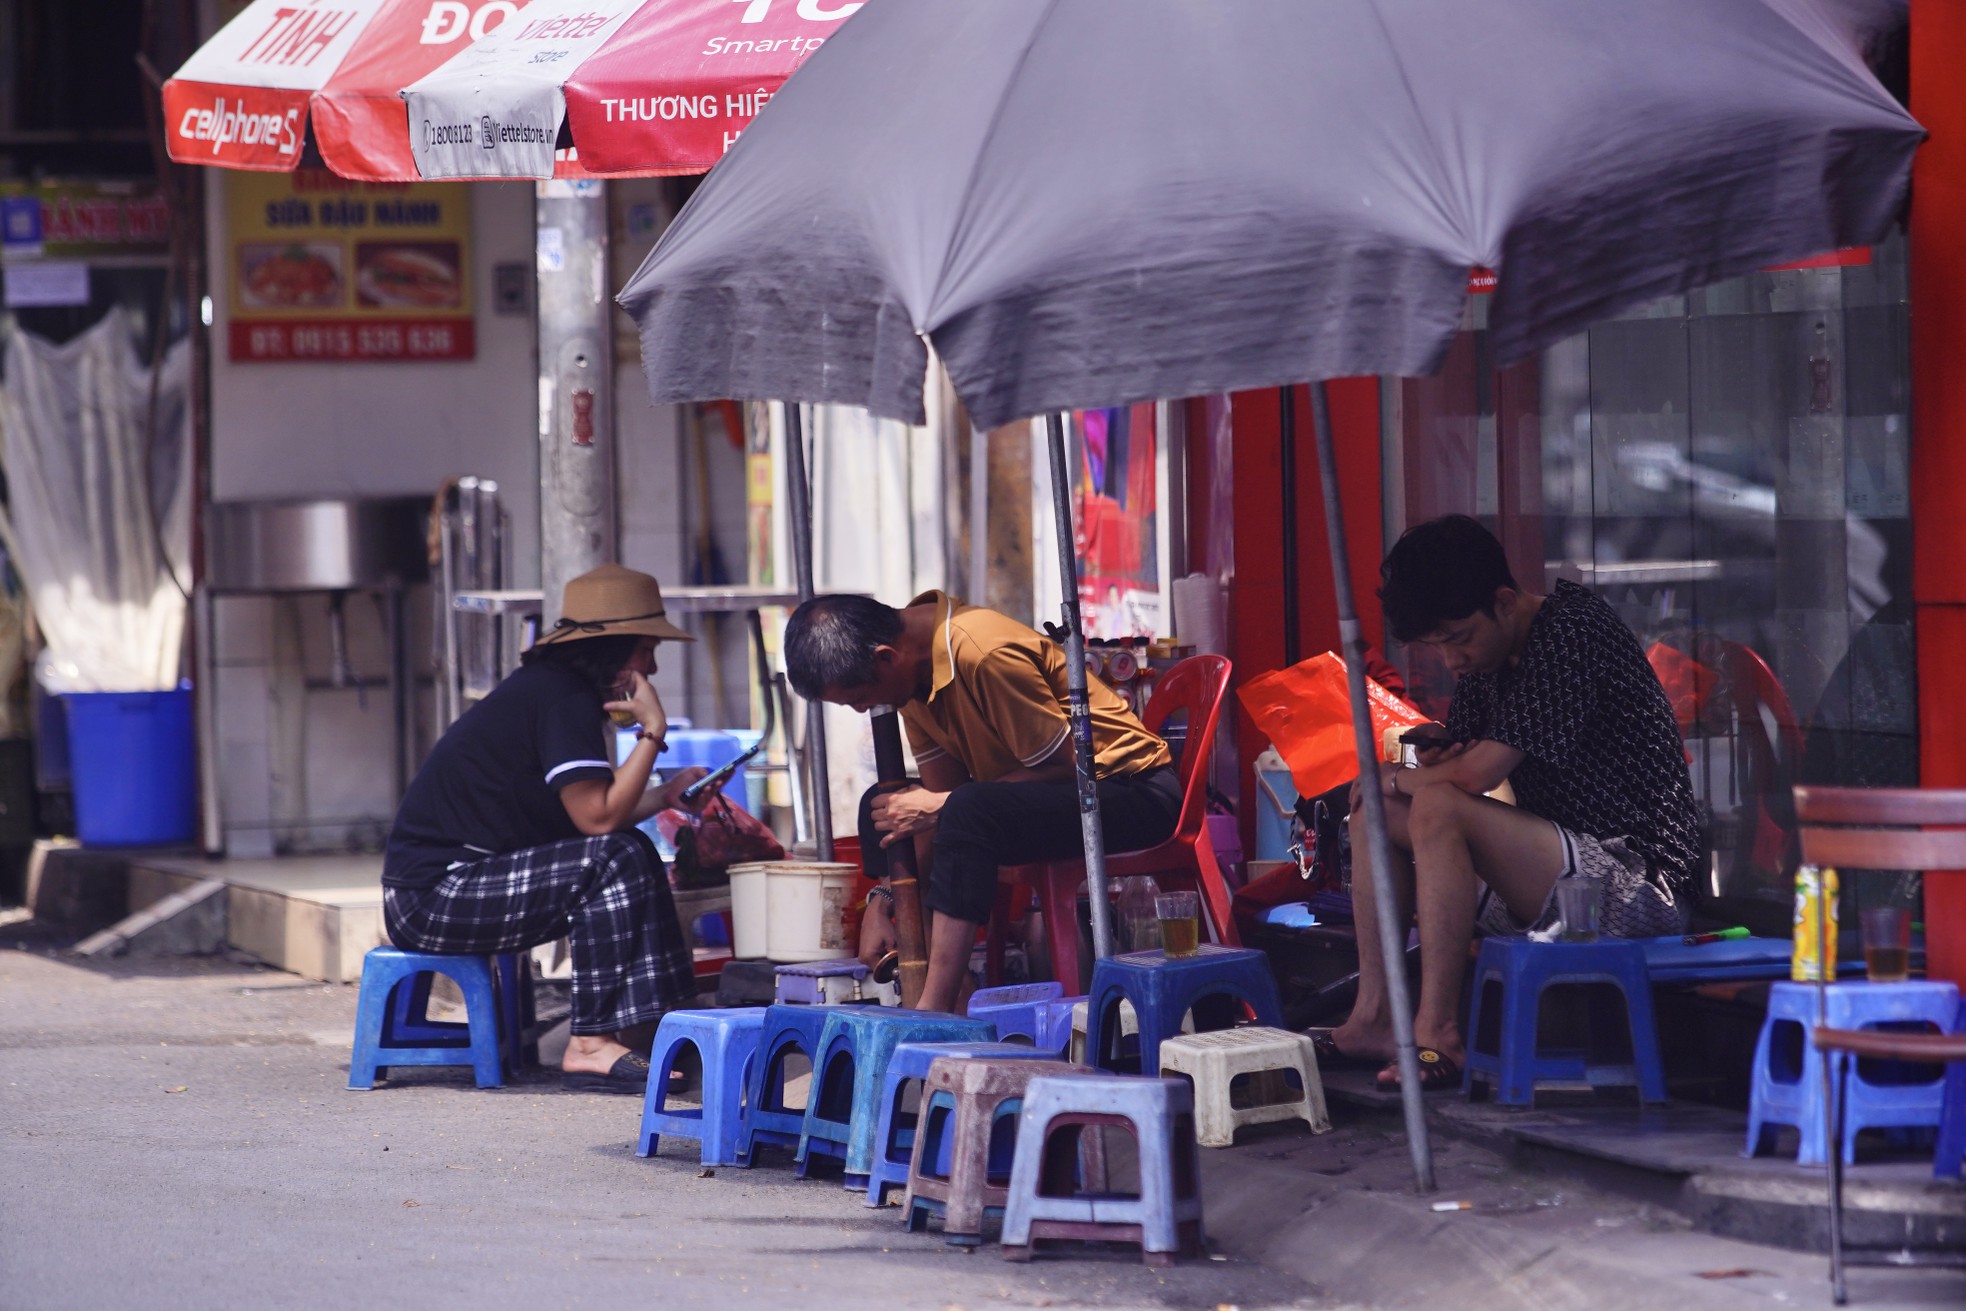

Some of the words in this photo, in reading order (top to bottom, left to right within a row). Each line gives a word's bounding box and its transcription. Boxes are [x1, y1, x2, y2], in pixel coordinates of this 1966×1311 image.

[527, 49, 569, 64] store
[600, 94, 718, 122] THƯƠNG
[725, 87, 775, 118] HIÊ
